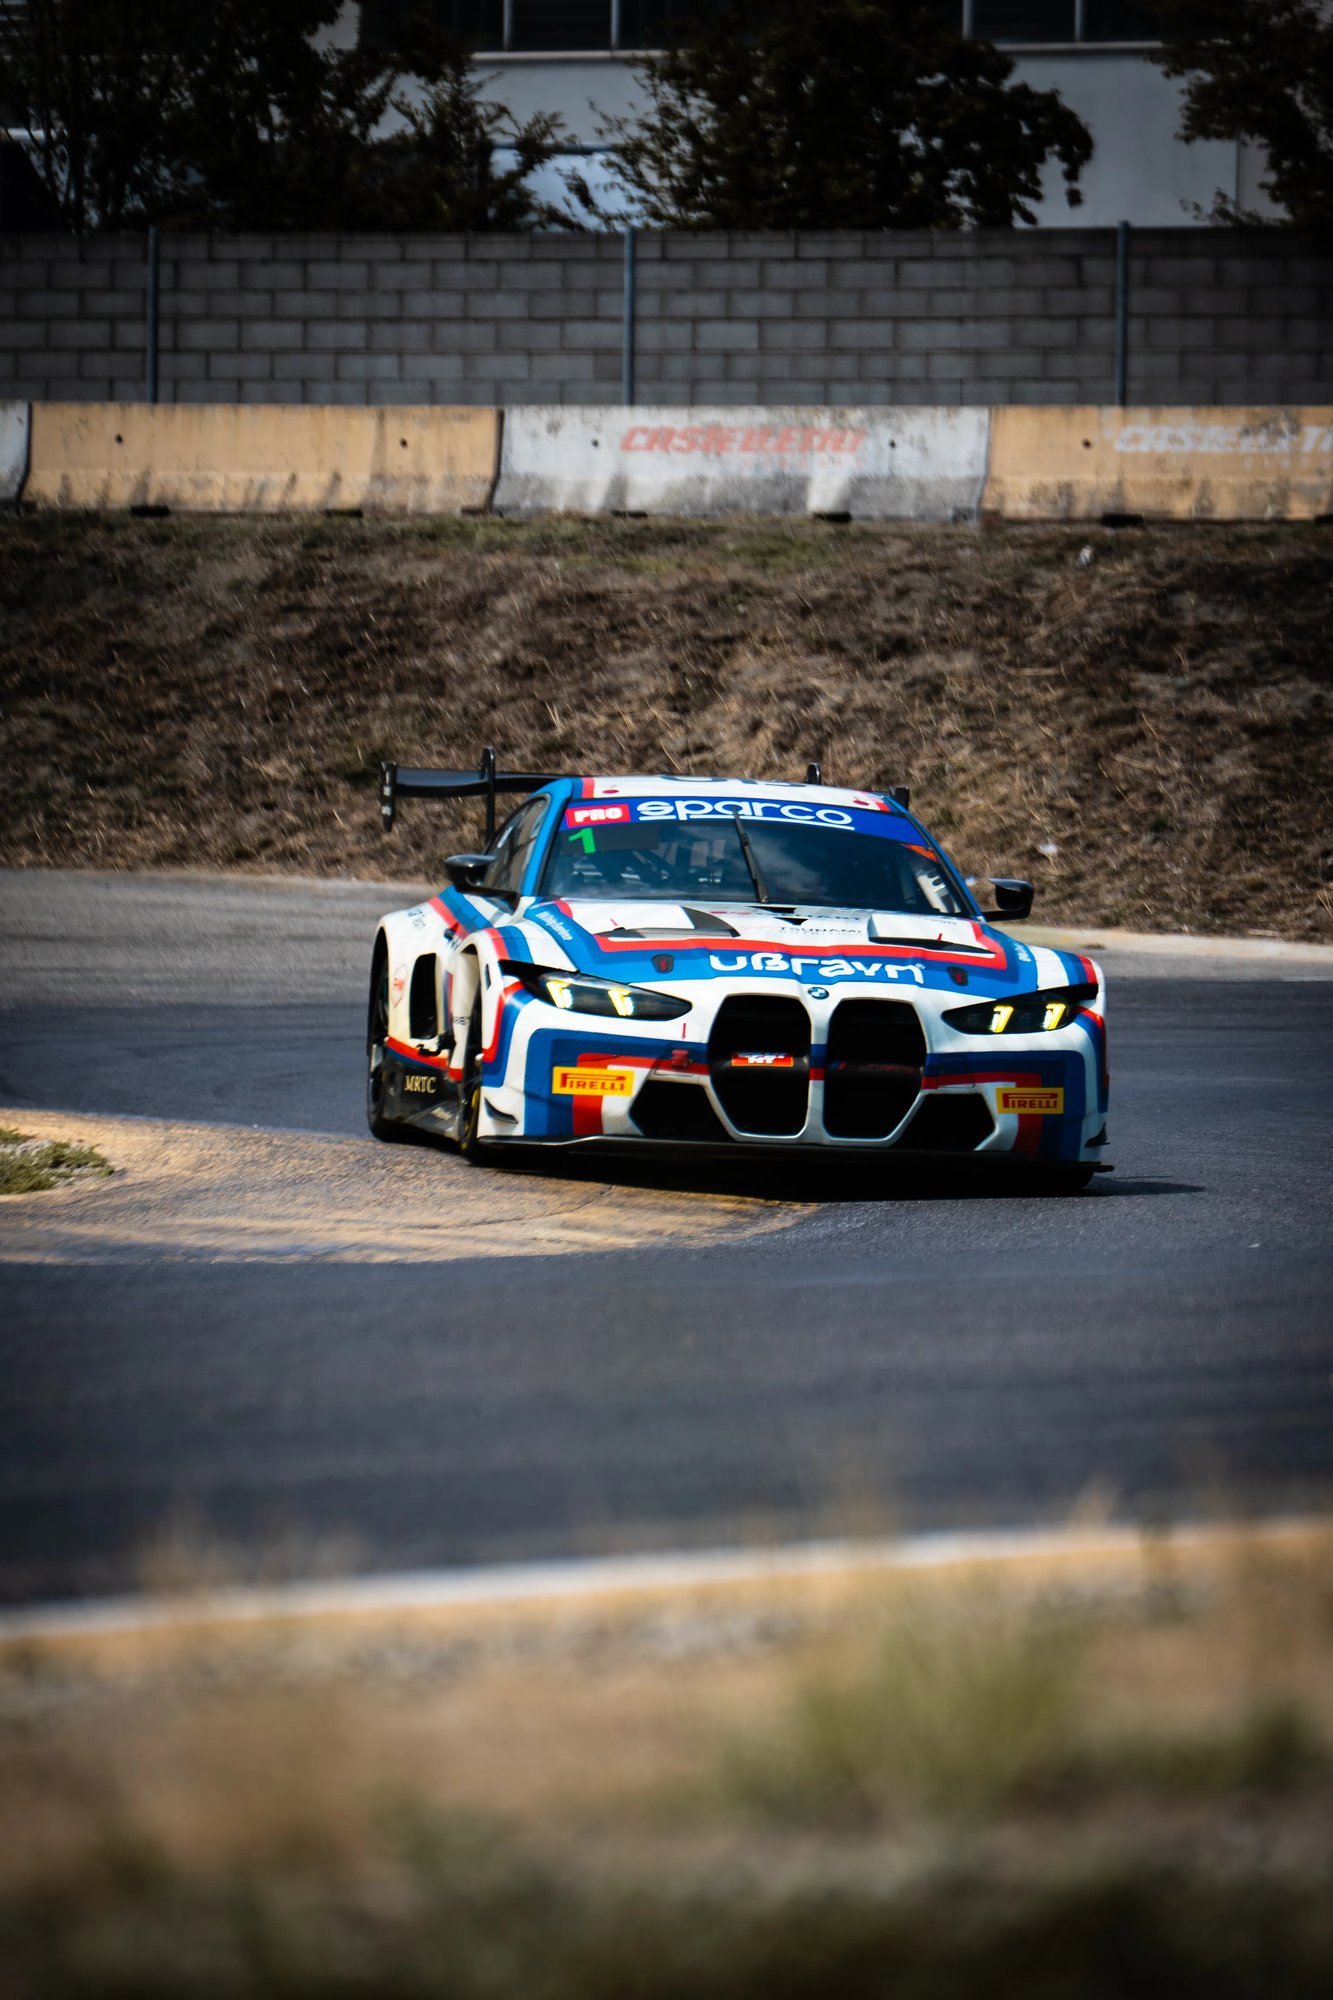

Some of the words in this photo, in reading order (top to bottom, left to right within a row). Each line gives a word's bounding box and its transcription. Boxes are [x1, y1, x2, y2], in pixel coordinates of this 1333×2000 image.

[574, 807, 622, 823] PRO
[636, 800, 854, 827] sparco
[568, 827, 596, 854] 1
[560, 1072, 626, 1092] PIRELLI
[1002, 1092, 1059, 1109] PIRELLI
